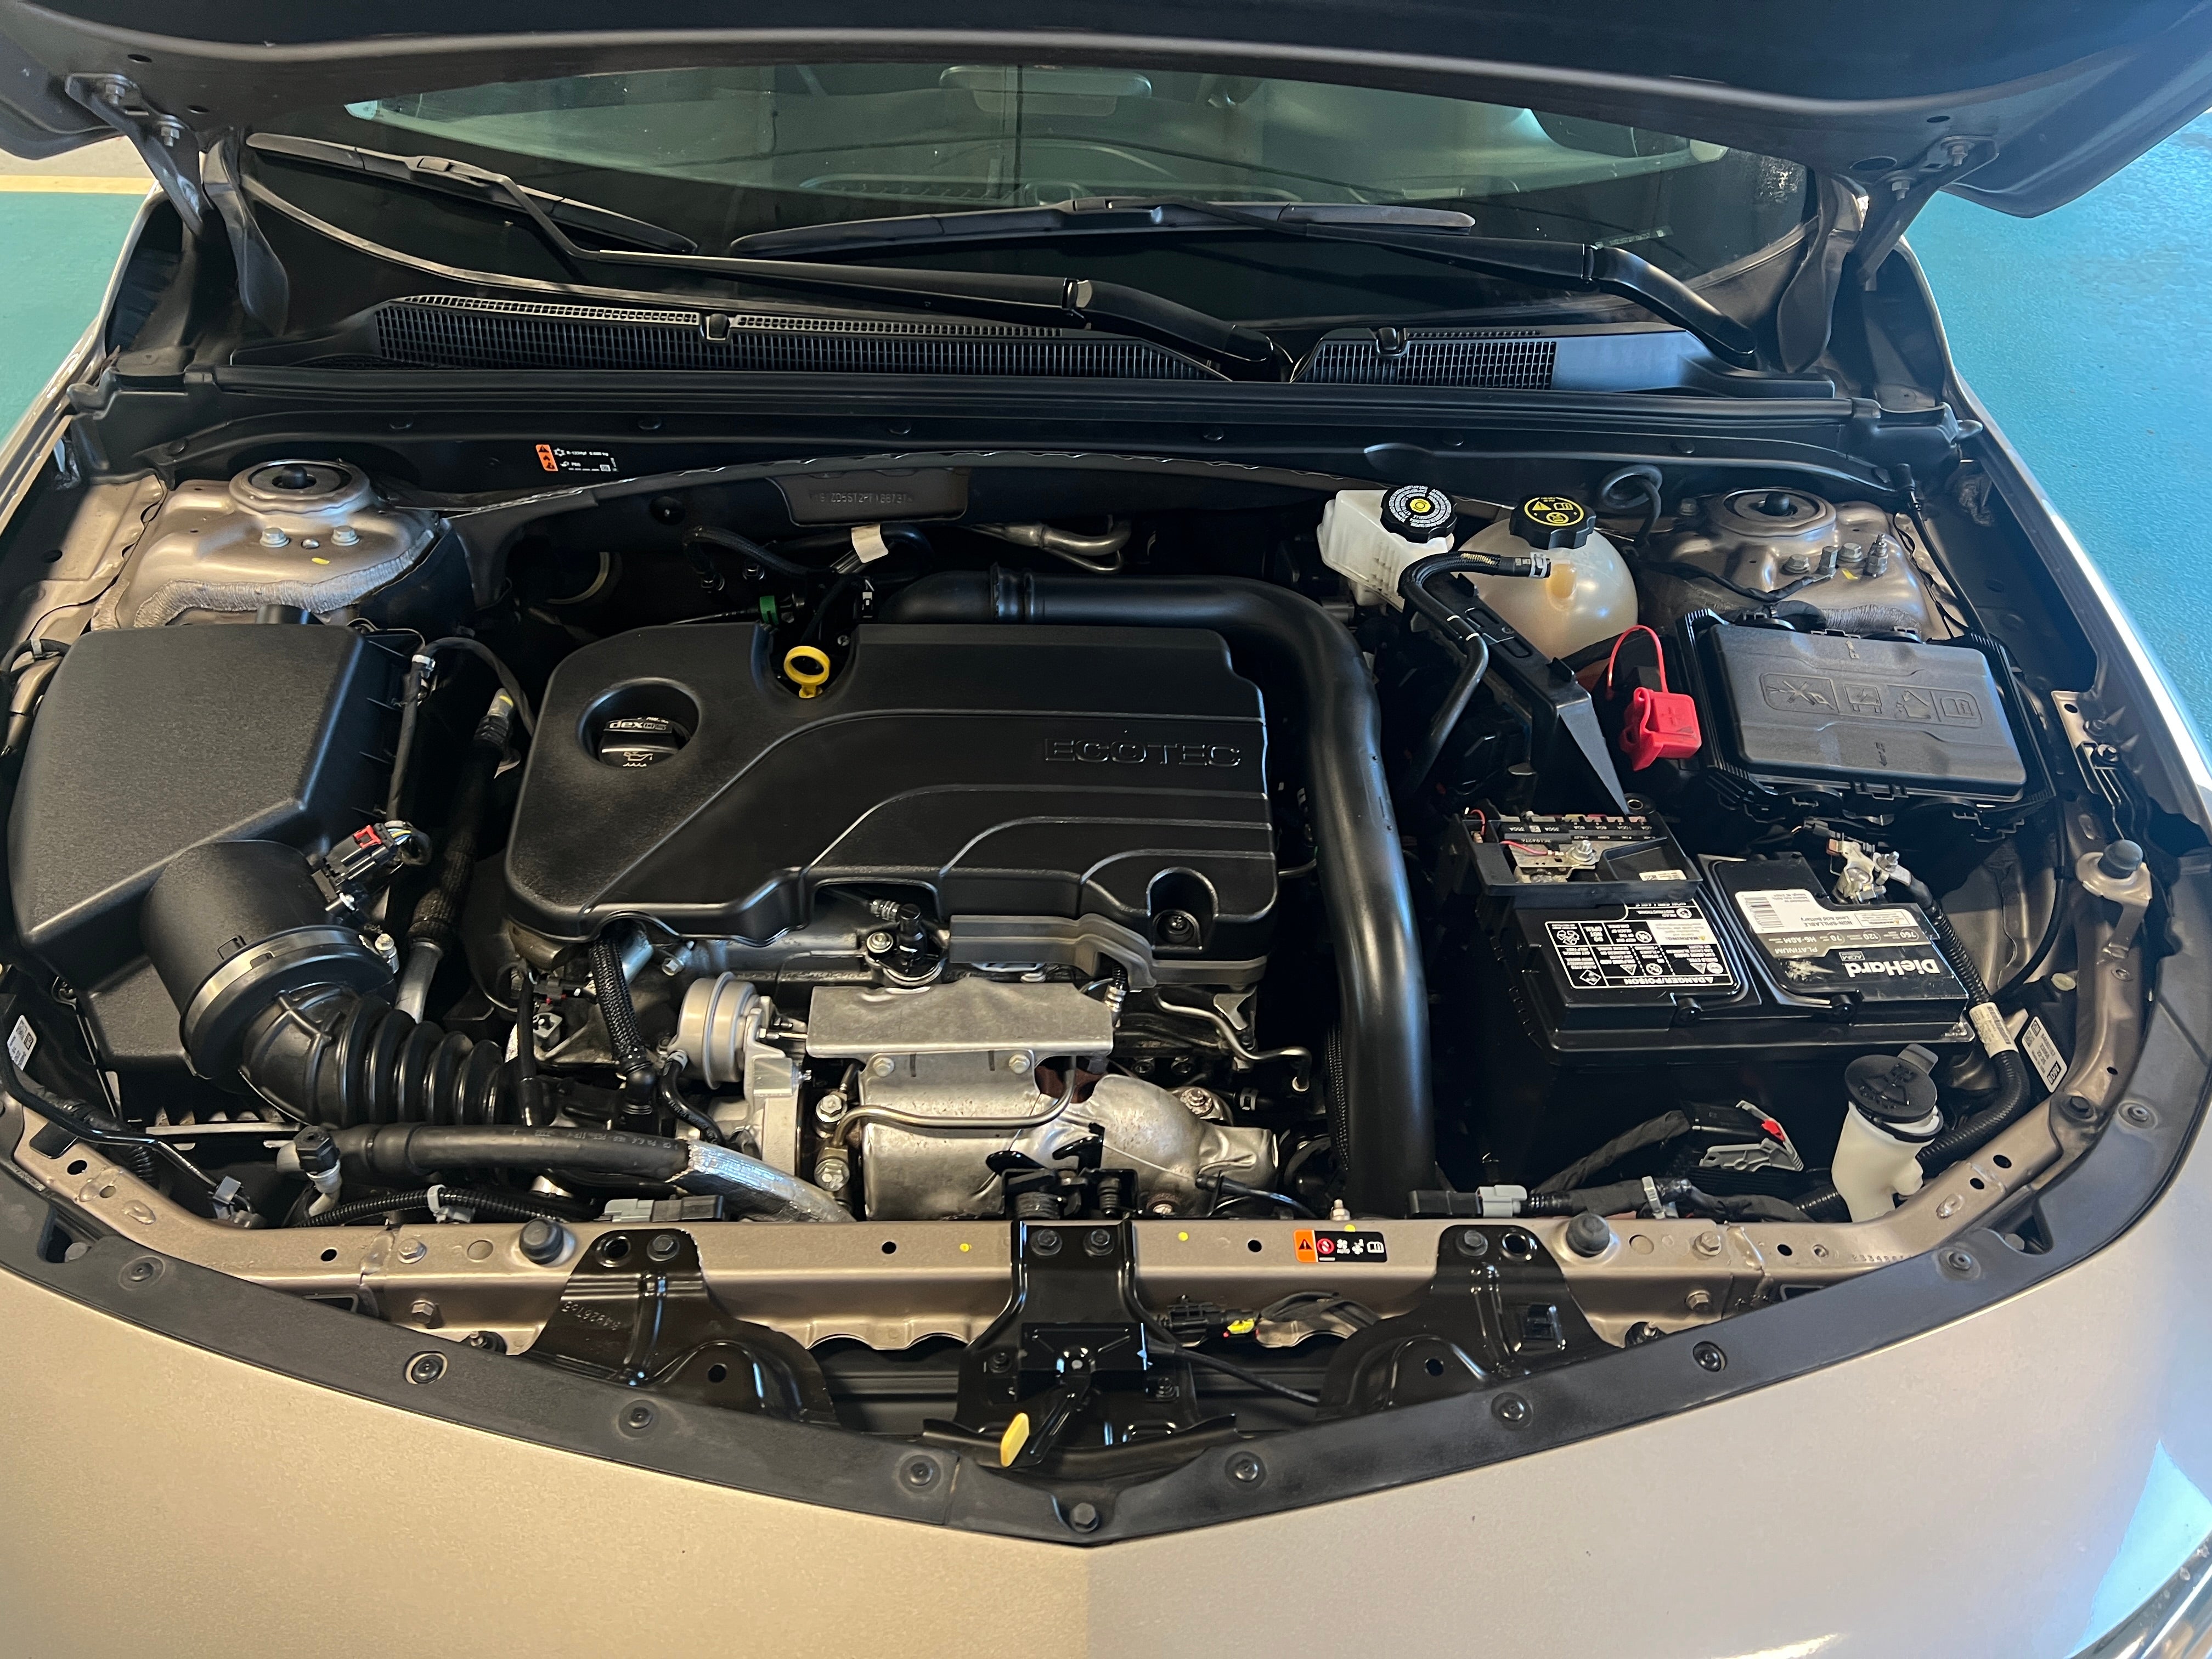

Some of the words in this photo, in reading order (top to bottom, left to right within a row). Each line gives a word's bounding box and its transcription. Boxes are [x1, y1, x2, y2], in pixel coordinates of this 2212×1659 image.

[609, 720, 667, 731] dexos
[1045, 738, 1241, 768] ECOTEC
[1843, 959, 1940, 978] DieHard
[1624, 977, 1706, 985] DANGER/POISON
